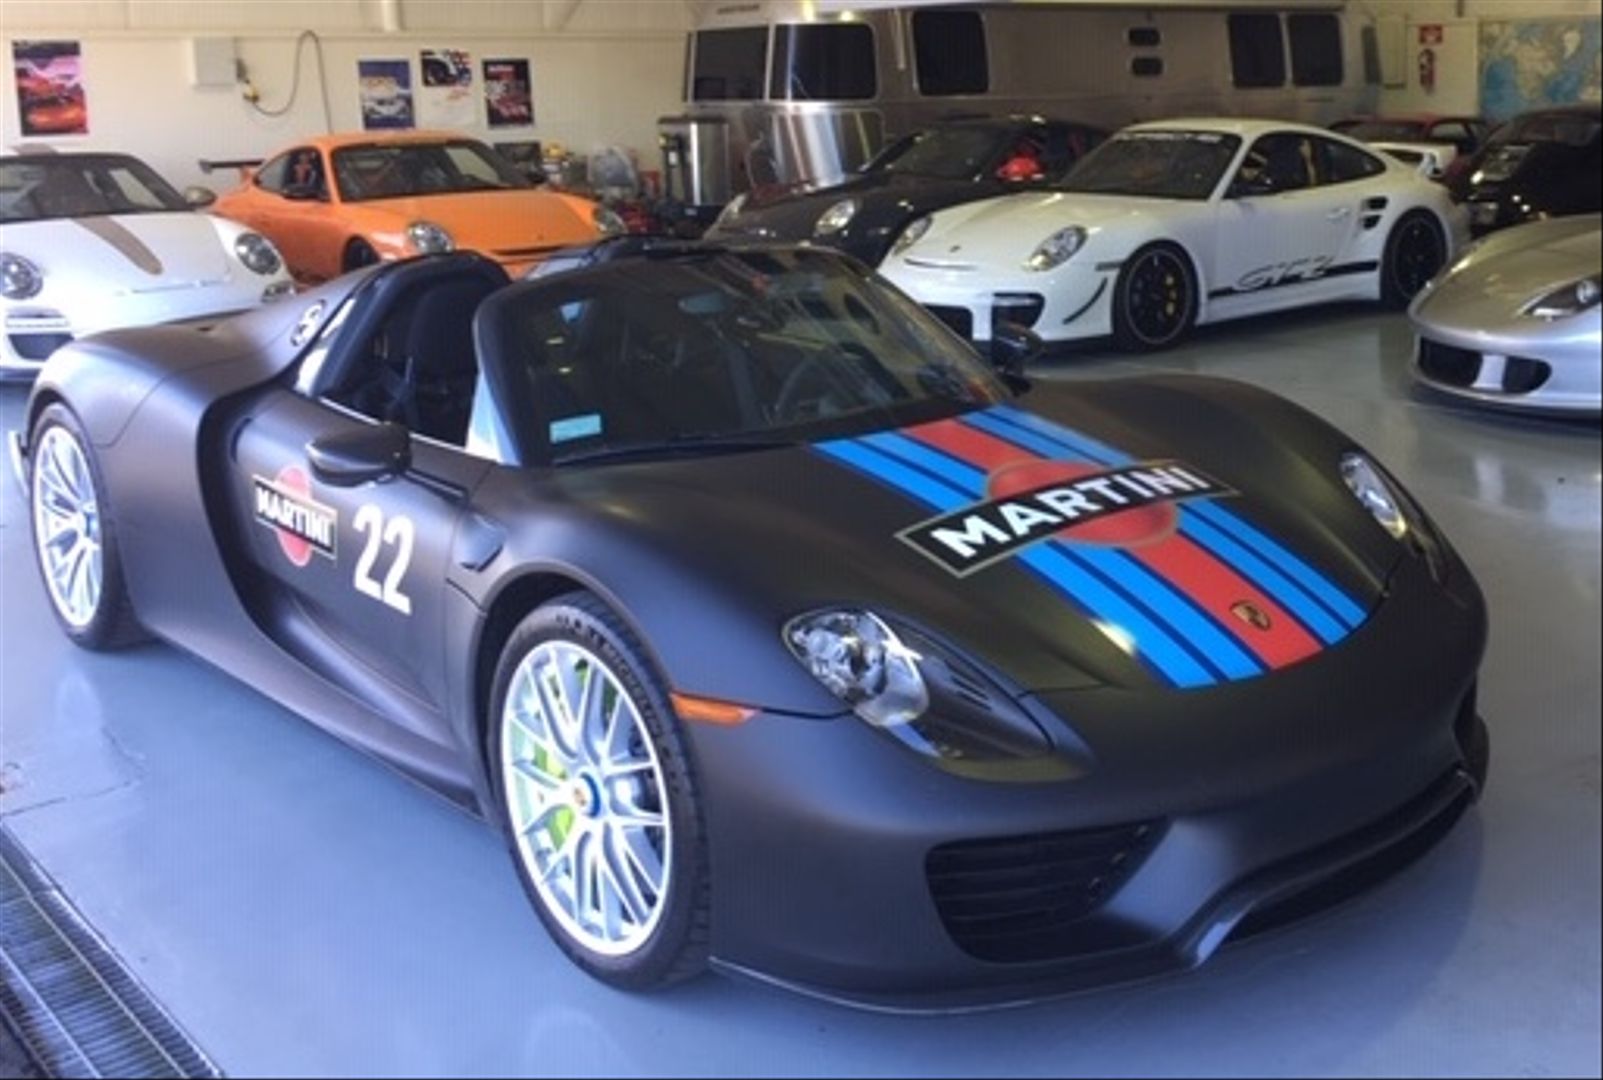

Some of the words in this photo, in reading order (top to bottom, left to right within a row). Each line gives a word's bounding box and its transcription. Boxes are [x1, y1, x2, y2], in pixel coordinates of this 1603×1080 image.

[255, 486, 332, 547] MARTINI
[930, 466, 1210, 558] MARTINI
[353, 503, 414, 615] 22
